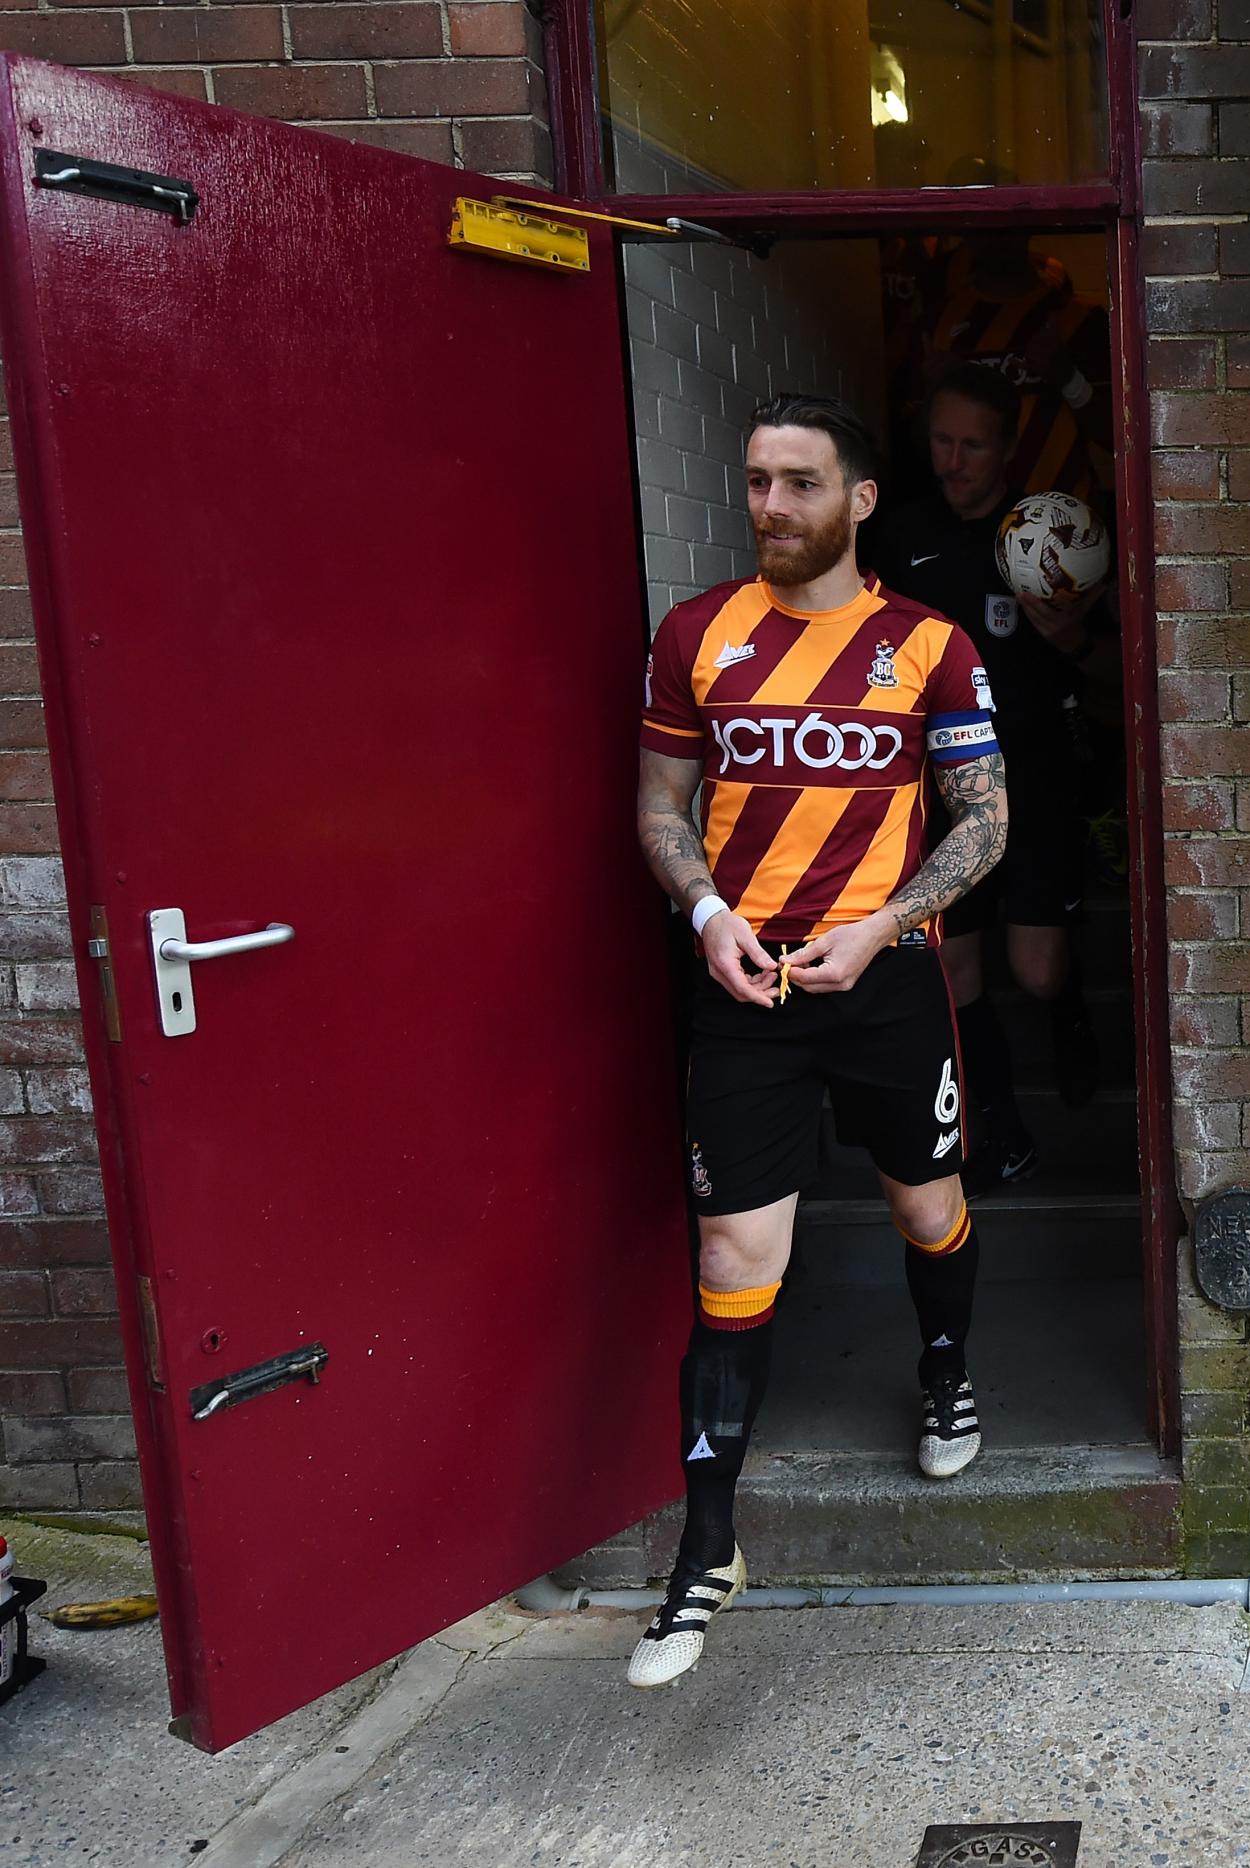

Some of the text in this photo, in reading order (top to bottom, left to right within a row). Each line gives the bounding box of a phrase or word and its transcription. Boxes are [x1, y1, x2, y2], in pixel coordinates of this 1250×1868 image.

[994, 619, 1009, 628] EFL
[876, 662, 891, 676] BC
[974, 674, 987, 685] sky
[953, 730, 973, 741] EFL
[711, 712, 903, 774] JCT600
[934, 1057, 959, 1124] 6
[970, 1837, 1034, 1859] GAS
